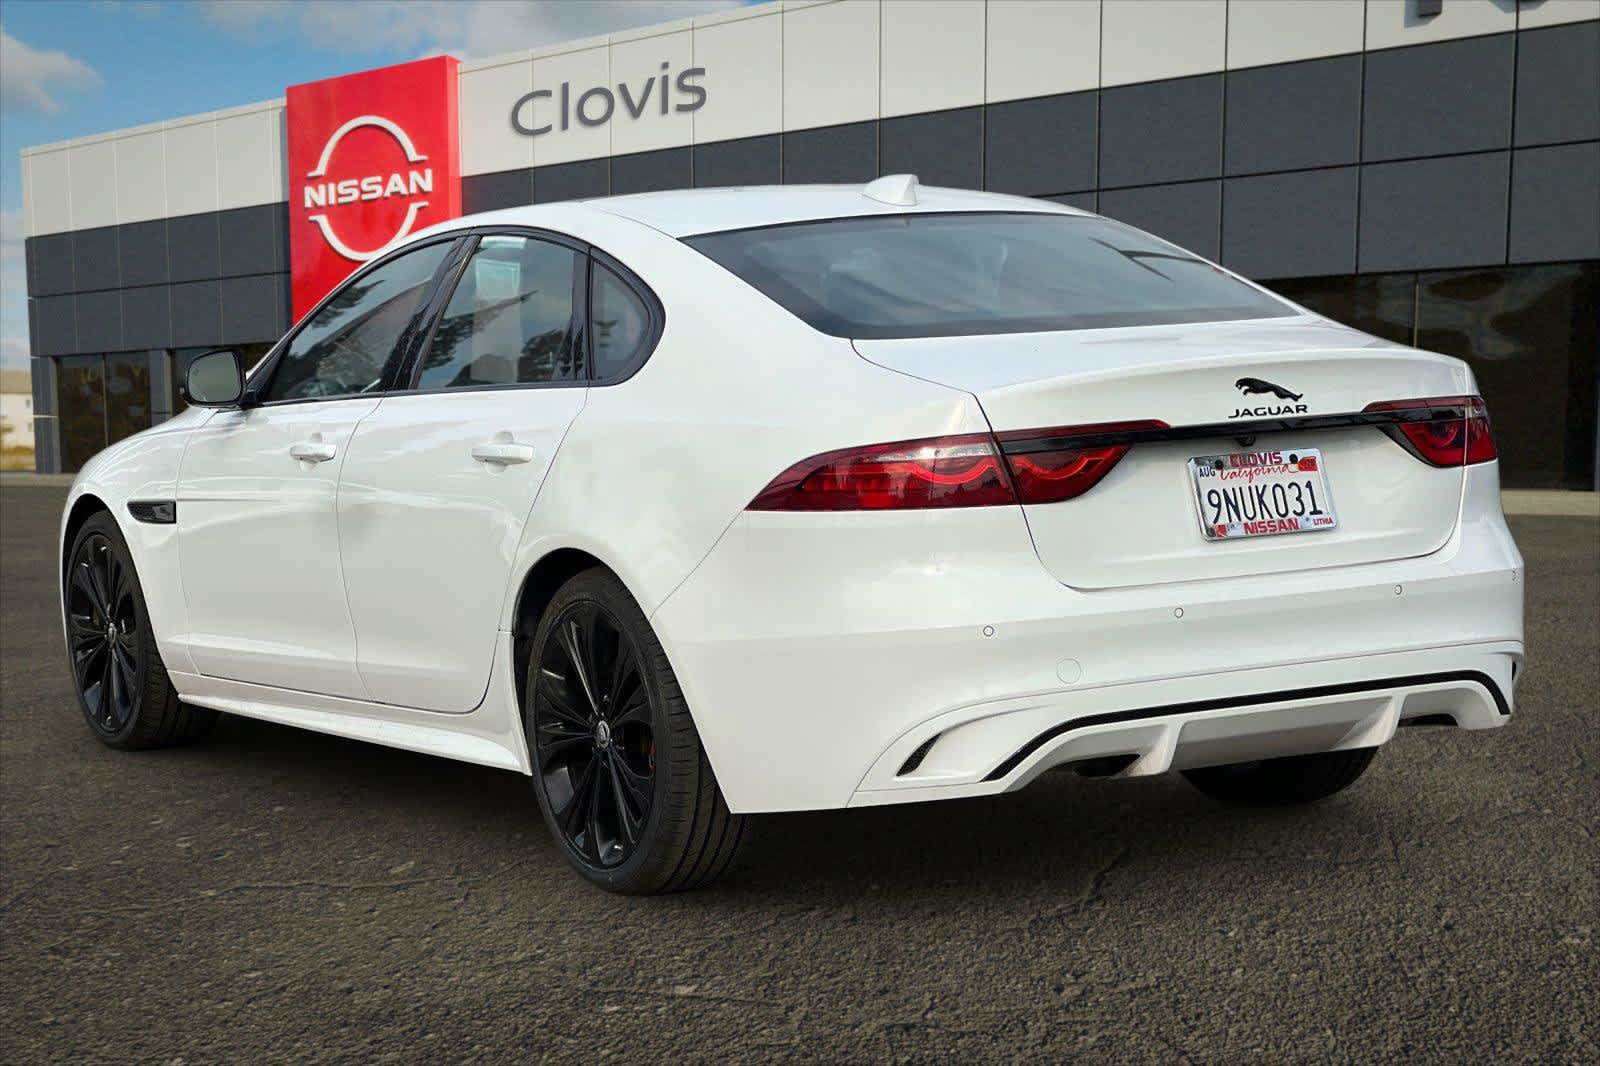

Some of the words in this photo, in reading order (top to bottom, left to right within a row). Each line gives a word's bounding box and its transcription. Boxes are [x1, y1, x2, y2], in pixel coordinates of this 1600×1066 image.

[511, 62, 708, 137] Clovis
[303, 169, 434, 208] NISSAN
[1228, 404, 1308, 418] JAGUAR
[1230, 452, 1283, 468] CLOVIS
[1199, 466, 1215, 478] AUG
[1207, 480, 1323, 524] 9NUK031
[1243, 518, 1300, 535] NISSAN
[1313, 517, 1334, 526] LITHIA
